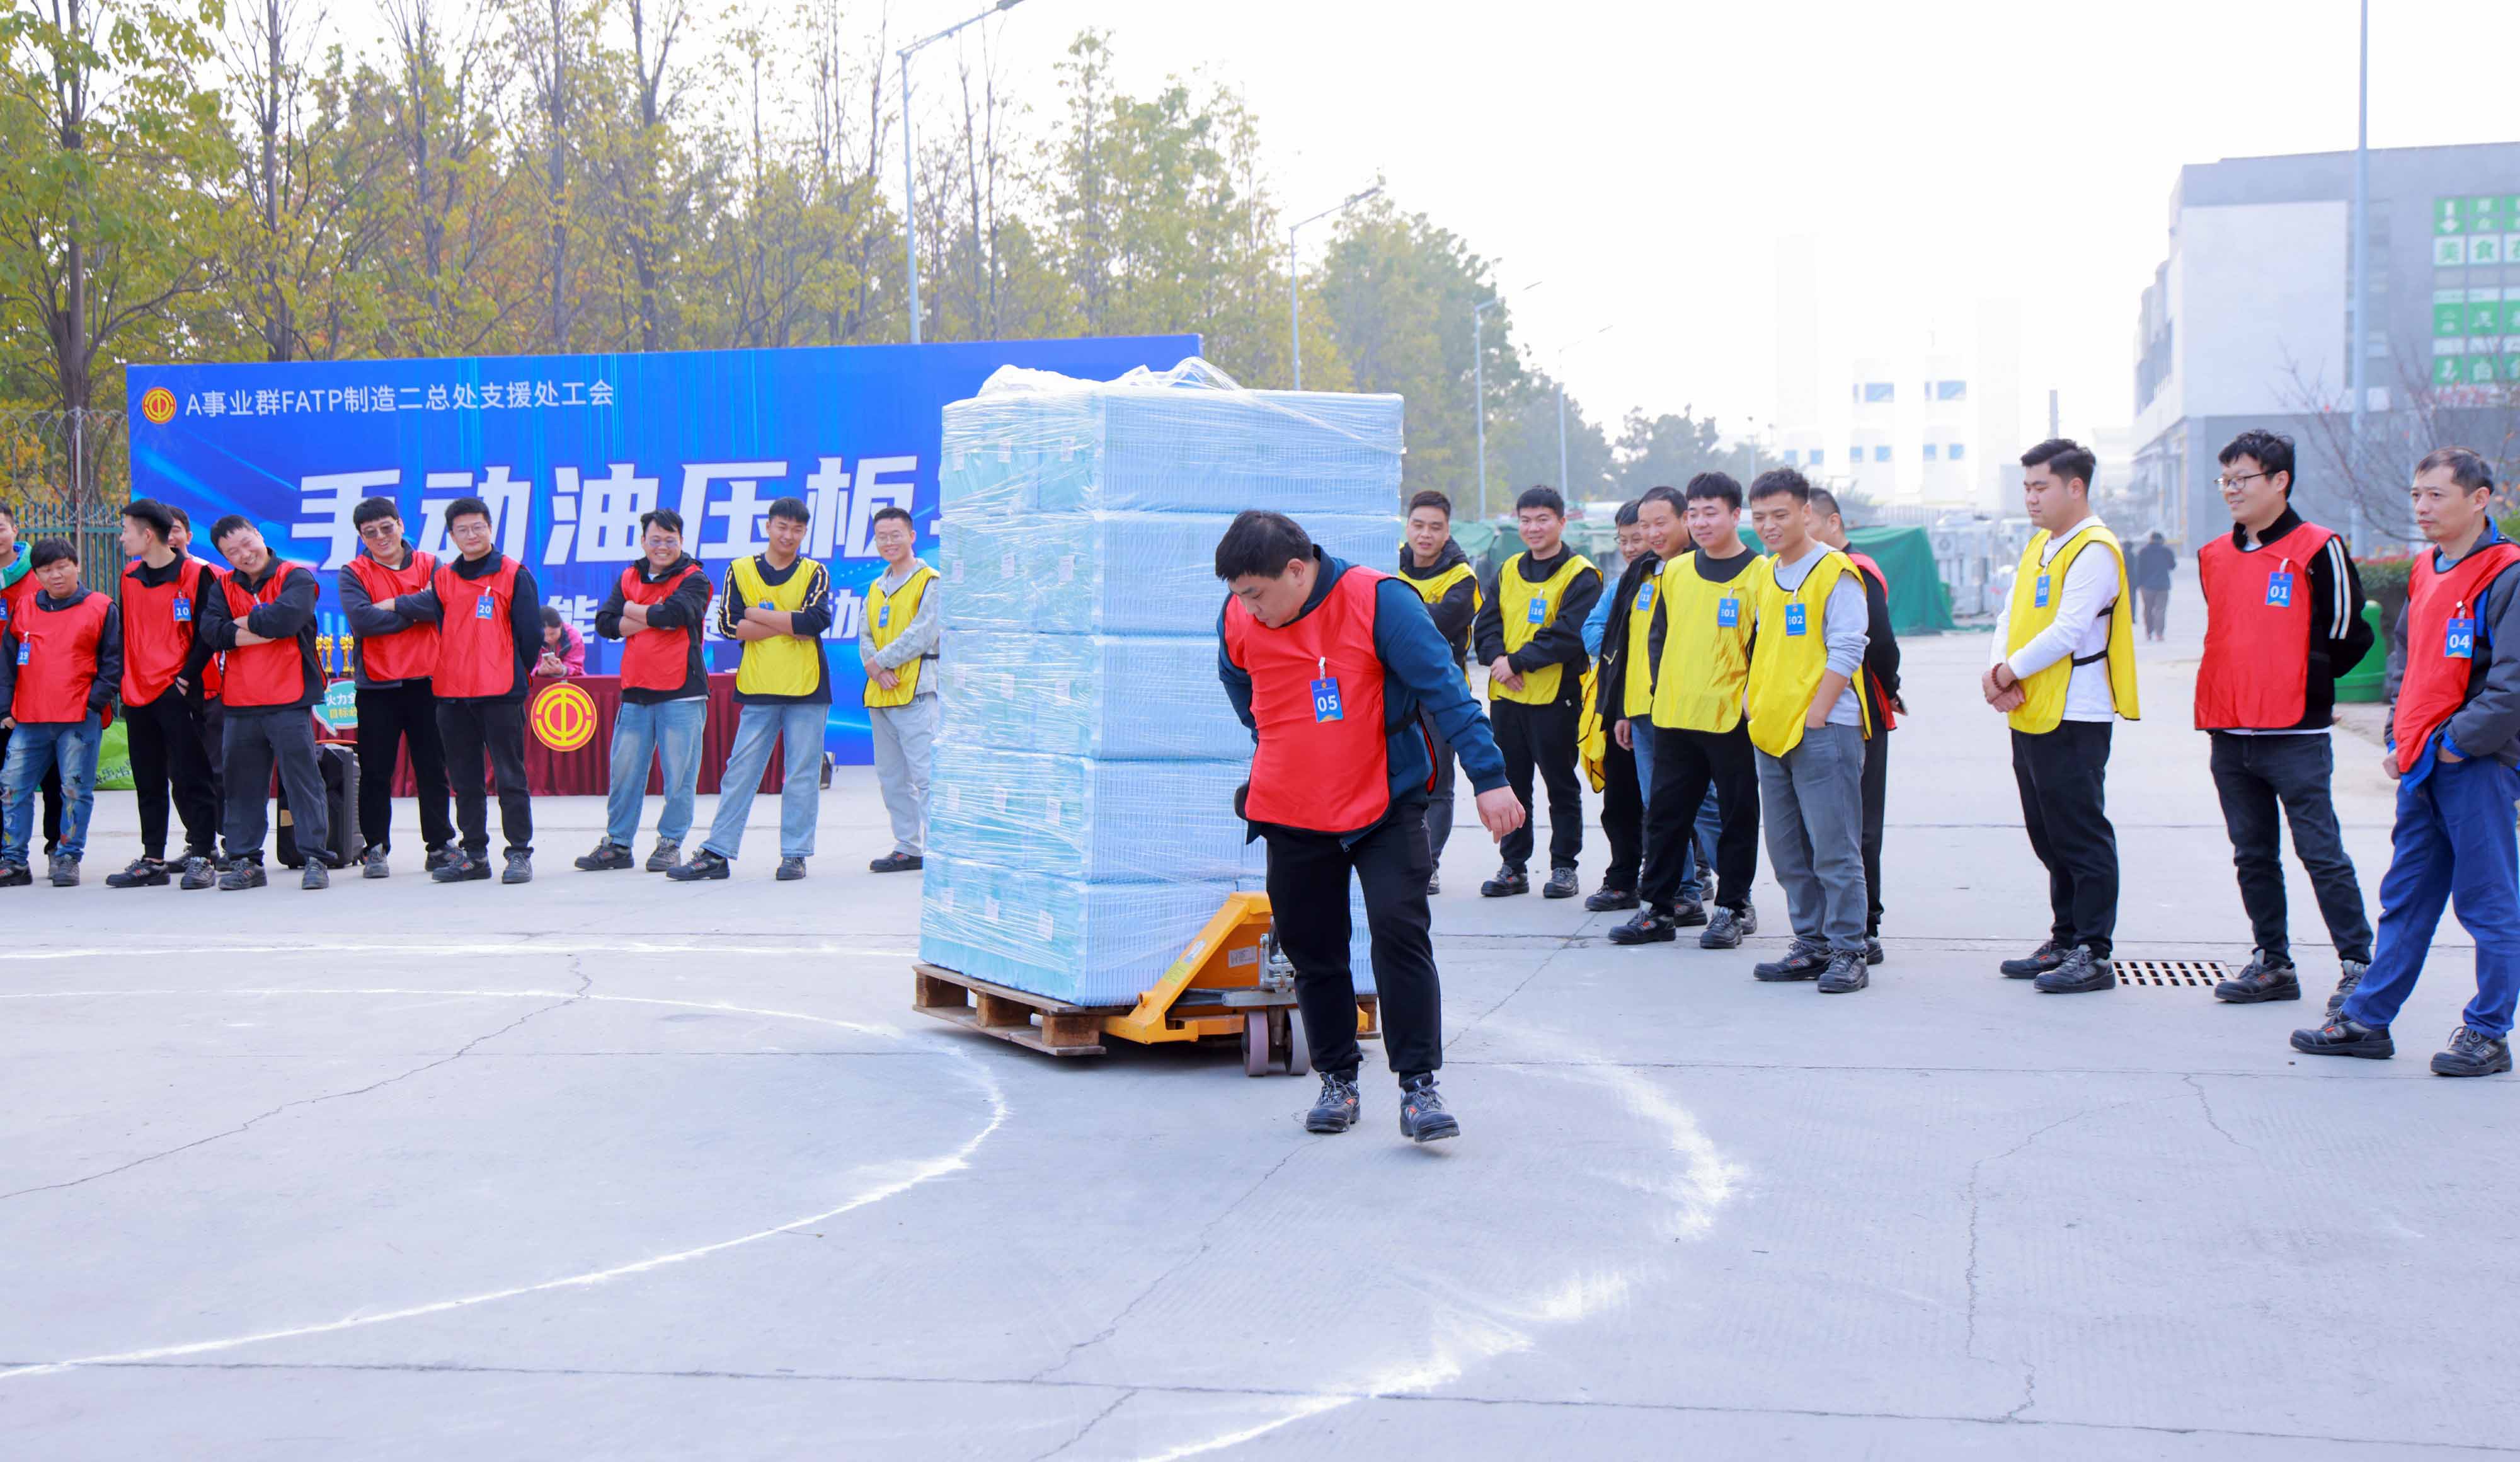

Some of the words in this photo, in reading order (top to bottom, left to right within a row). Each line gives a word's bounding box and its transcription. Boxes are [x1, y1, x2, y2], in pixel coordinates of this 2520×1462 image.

[186, 379, 614, 417] A事业群FATP制造二总处支援处工会
[291, 455, 940, 570] 手动油压板
[2270, 585, 2288, 599] 01
[176, 607, 189, 616] 10
[479, 604, 491, 614] 20
[1724, 609, 1736, 618] 01
[1791, 615, 1804, 625] 02
[2449, 634, 2470, 649] 04
[20, 651, 29, 660] 19
[1317, 694, 1338, 712] 05
